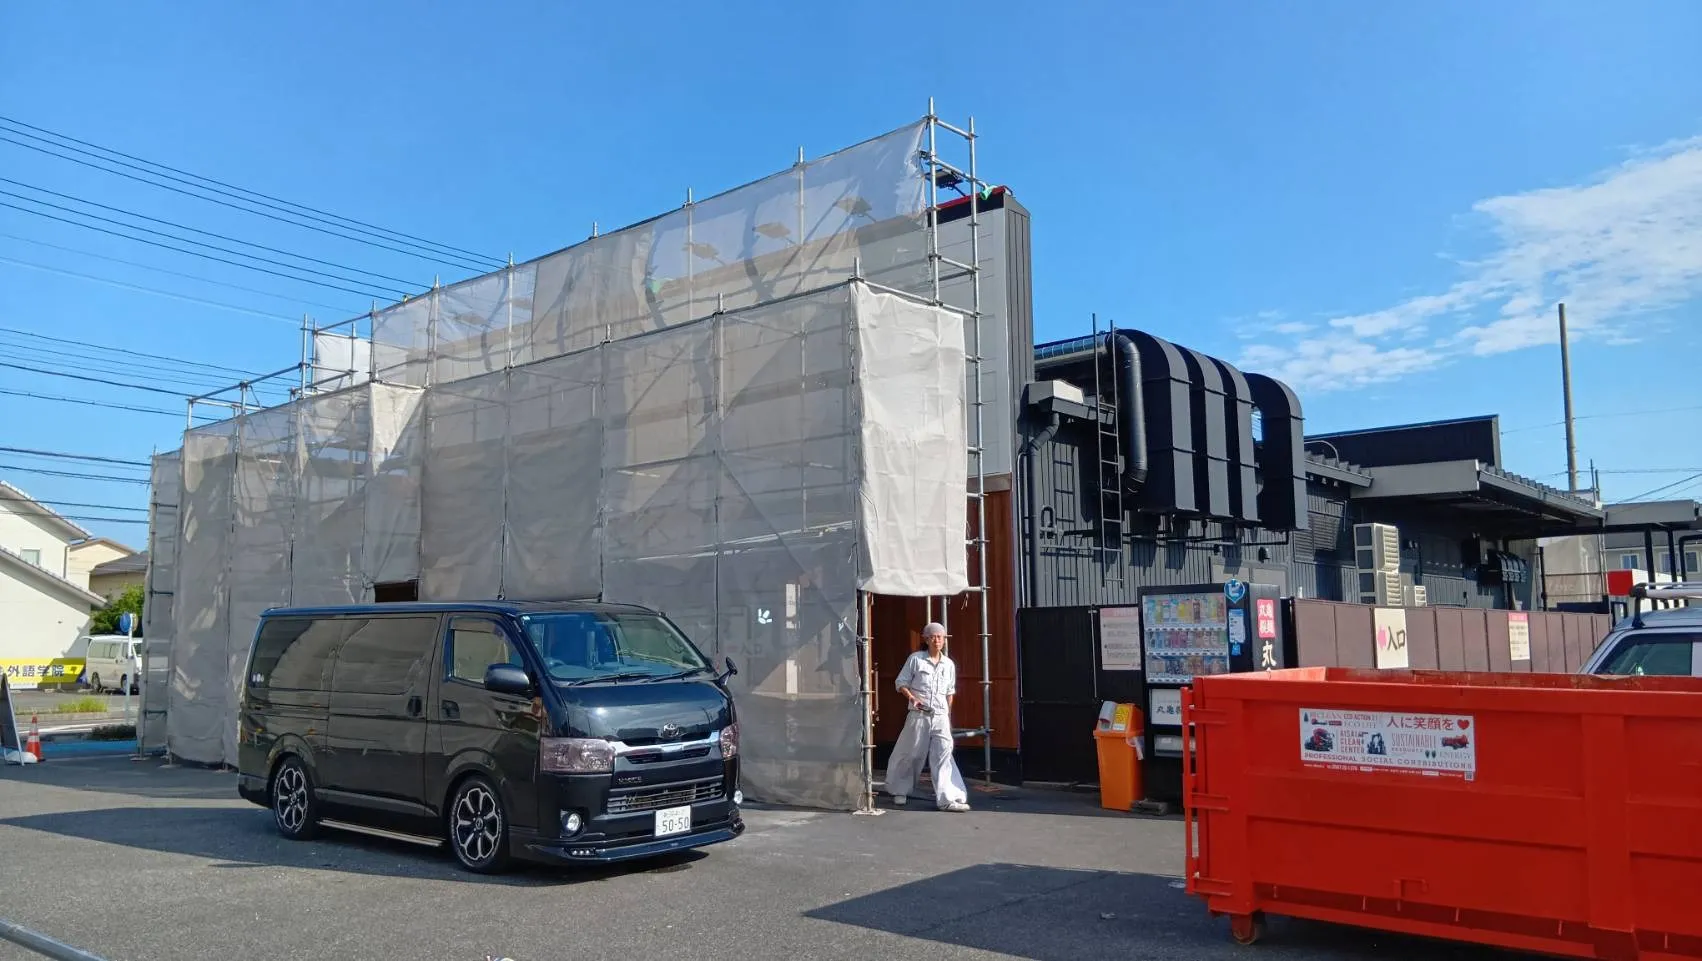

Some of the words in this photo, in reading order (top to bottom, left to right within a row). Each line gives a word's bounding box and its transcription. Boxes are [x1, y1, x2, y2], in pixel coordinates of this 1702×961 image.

[1261, 640, 1277, 672] 丸
[0, 664, 64, 677] 外語学院
[1387, 716, 1454, 730] 人に笑顔を
[1304, 752, 1357, 762] PROFESSIONAL
[1361, 756, 1393, 764] SOCIAL
[1397, 759, 1472, 769] CONTRIBUTIONS
[662, 817, 690, 832] 50-50
